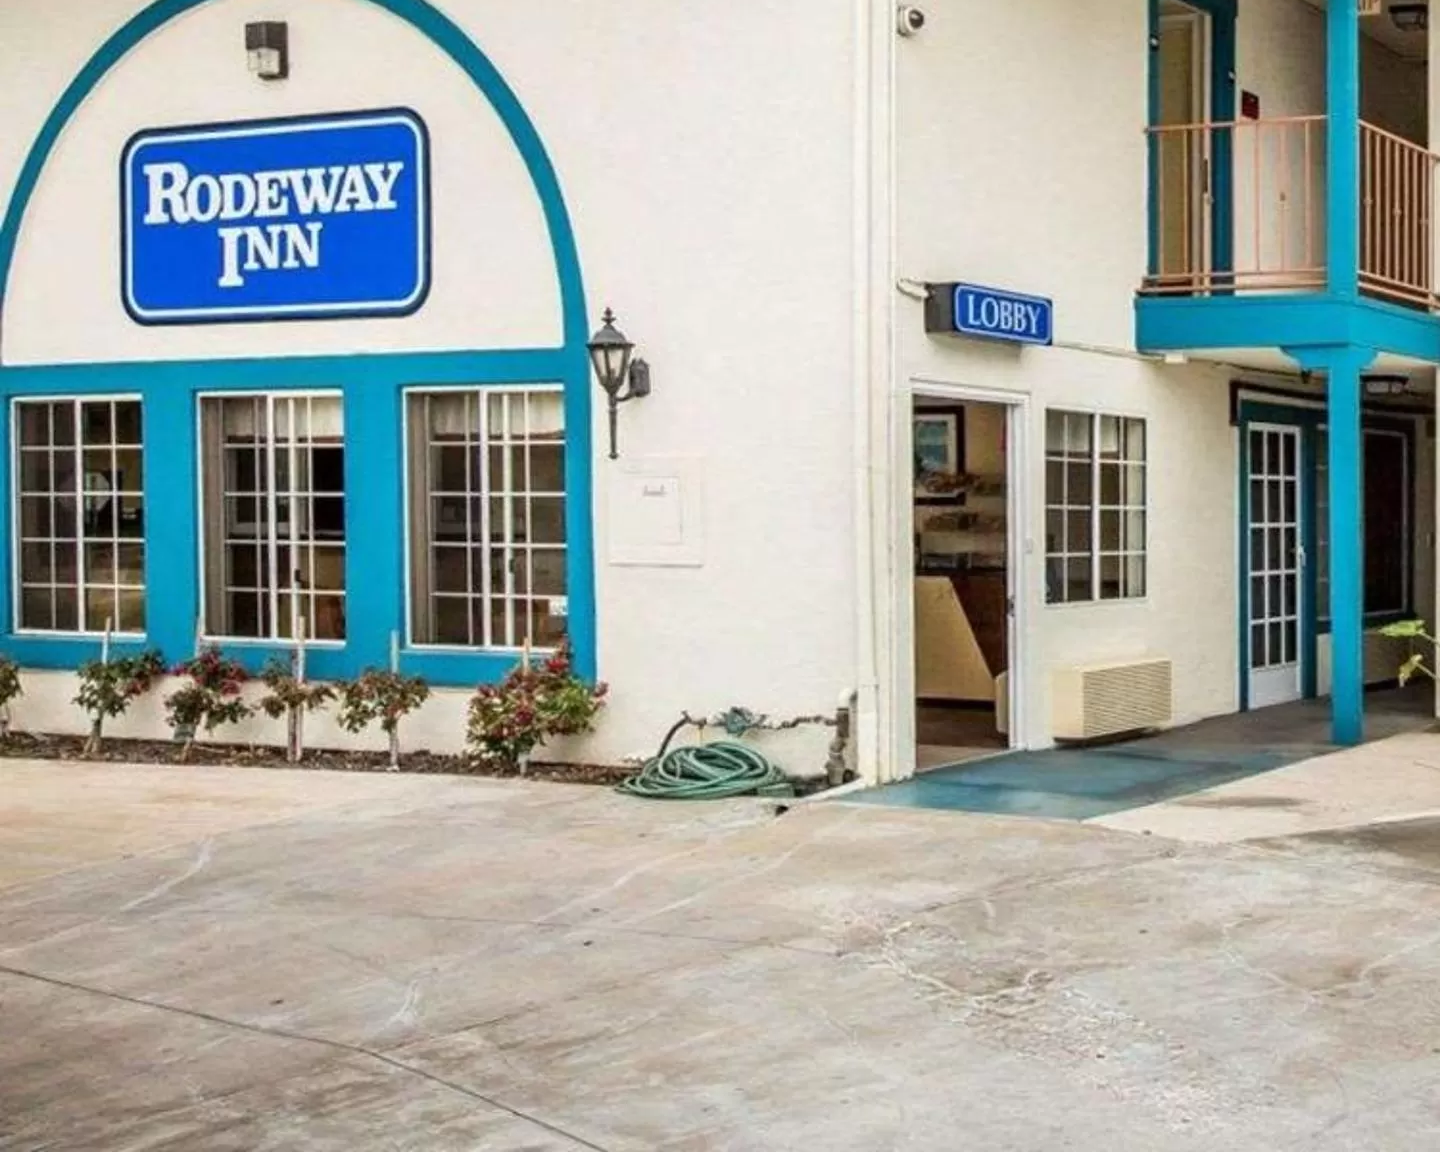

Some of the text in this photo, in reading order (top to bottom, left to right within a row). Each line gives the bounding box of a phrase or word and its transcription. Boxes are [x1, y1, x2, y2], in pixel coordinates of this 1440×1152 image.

[143, 161, 404, 225] RODEWAY
[217, 222, 323, 288] INN
[967, 293, 1041, 335] LOBBY
